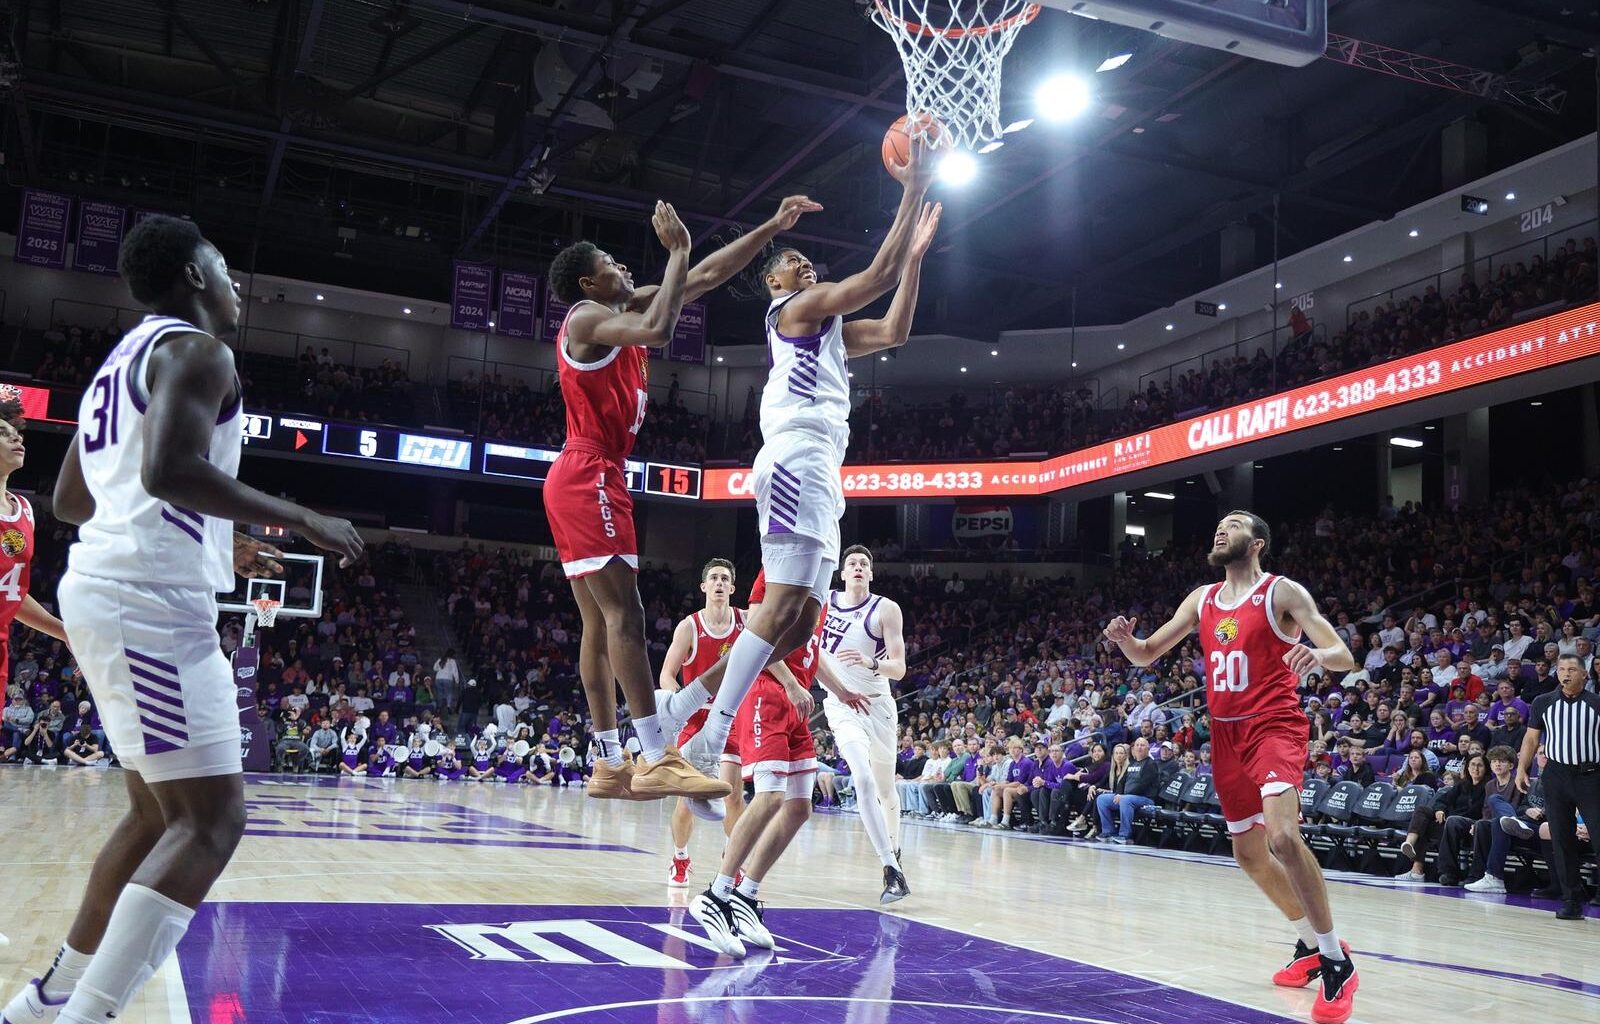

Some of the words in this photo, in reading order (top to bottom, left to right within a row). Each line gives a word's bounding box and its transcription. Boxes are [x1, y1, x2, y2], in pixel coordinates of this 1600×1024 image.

[30, 204, 64, 220] WAC
[86, 214, 120, 230] WAC
[1520, 204, 1553, 232] 204
[27, 236, 58, 250] 2025
[505, 286, 533, 299] NCAA
[459, 305, 484, 316] 2024
[1187, 415, 1233, 450] CALL
[1236, 398, 1289, 439] RAFI!
[1293, 361, 1441, 420] 623-388-4333
[1450, 337, 1547, 374] ACCIDENT
[1557, 321, 1600, 344] ATT
[84, 366, 121, 453] 31
[359, 430, 377, 457] 5
[401, 434, 468, 468] GCU
[1114, 434, 1151, 459] RAFI
[659, 469, 689, 496] 15
[843, 471, 983, 491] 623-388-4333
[990, 470, 1056, 485] ACCIDENT
[1059, 456, 1108, 478] ATTORNEY
[595, 473, 616, 538] JAGS
[956, 518, 1009, 531] PEPSI
[1210, 650, 1249, 692] 20
[753, 697, 763, 749] JAGS
[1331, 791, 1349, 801] GCU
[1366, 792, 1383, 802] GCU
[1398, 795, 1418, 804] GCU
